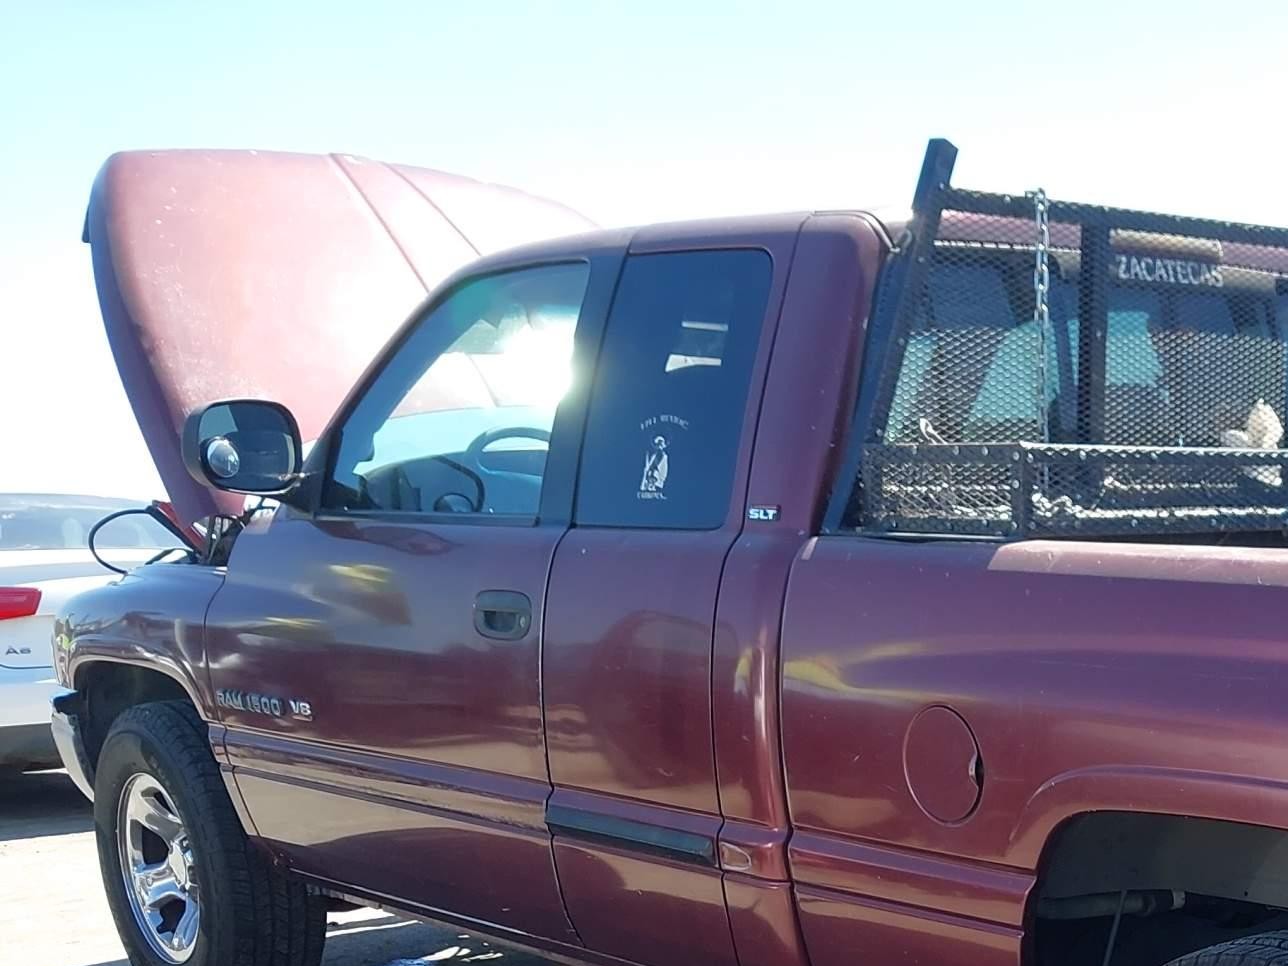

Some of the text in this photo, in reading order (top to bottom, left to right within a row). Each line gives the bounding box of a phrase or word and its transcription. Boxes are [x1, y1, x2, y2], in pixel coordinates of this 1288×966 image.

[1115, 253, 1224, 287] ZACATECAS
[749, 508, 778, 520] SLT
[216, 691, 312, 717] RAM 1500 V8
